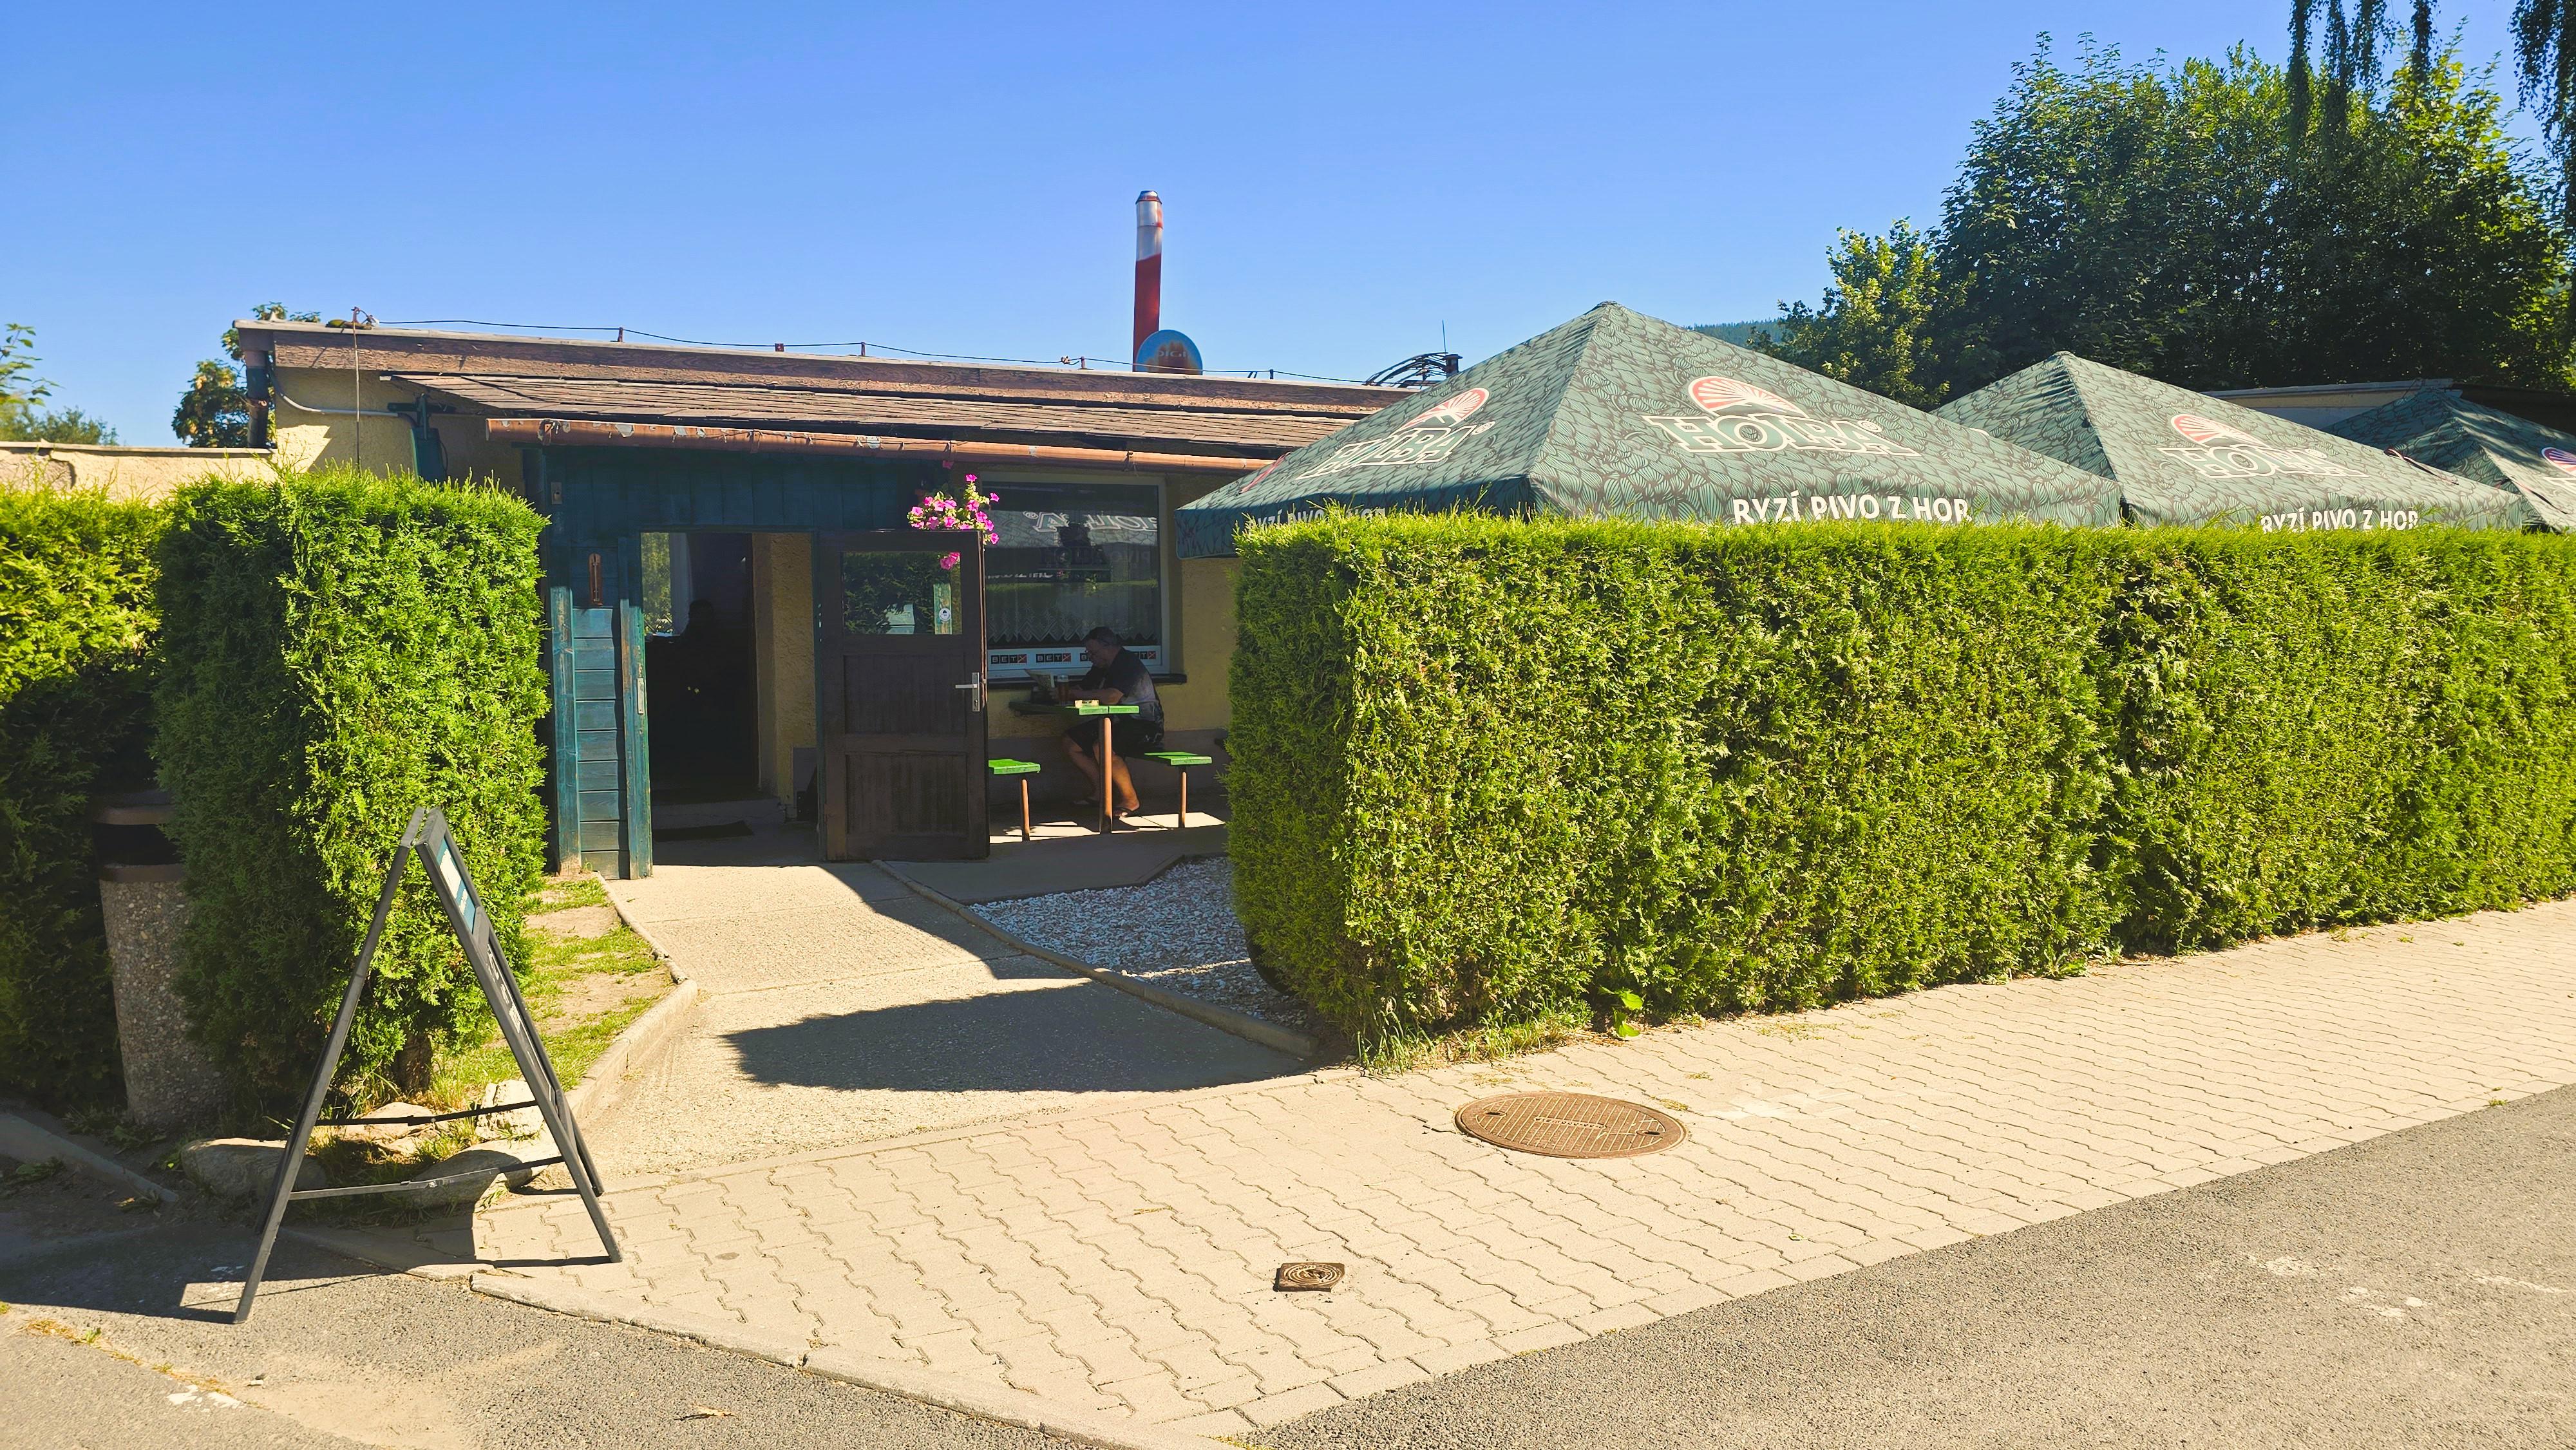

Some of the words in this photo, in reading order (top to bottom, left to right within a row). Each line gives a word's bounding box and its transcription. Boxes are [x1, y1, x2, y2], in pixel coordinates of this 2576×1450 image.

[1644, 413, 1922, 457] HOLBA
[1732, 490, 1801, 524] RYZÍ
[1810, 494, 1880, 520] PIVO
[1888, 495, 1908, 519] Z
[1913, 496, 1972, 523] HOR
[2260, 506, 2306, 534] RYZÍ
[2312, 509, 2357, 530] PIVO
[2363, 509, 2374, 530] Z
